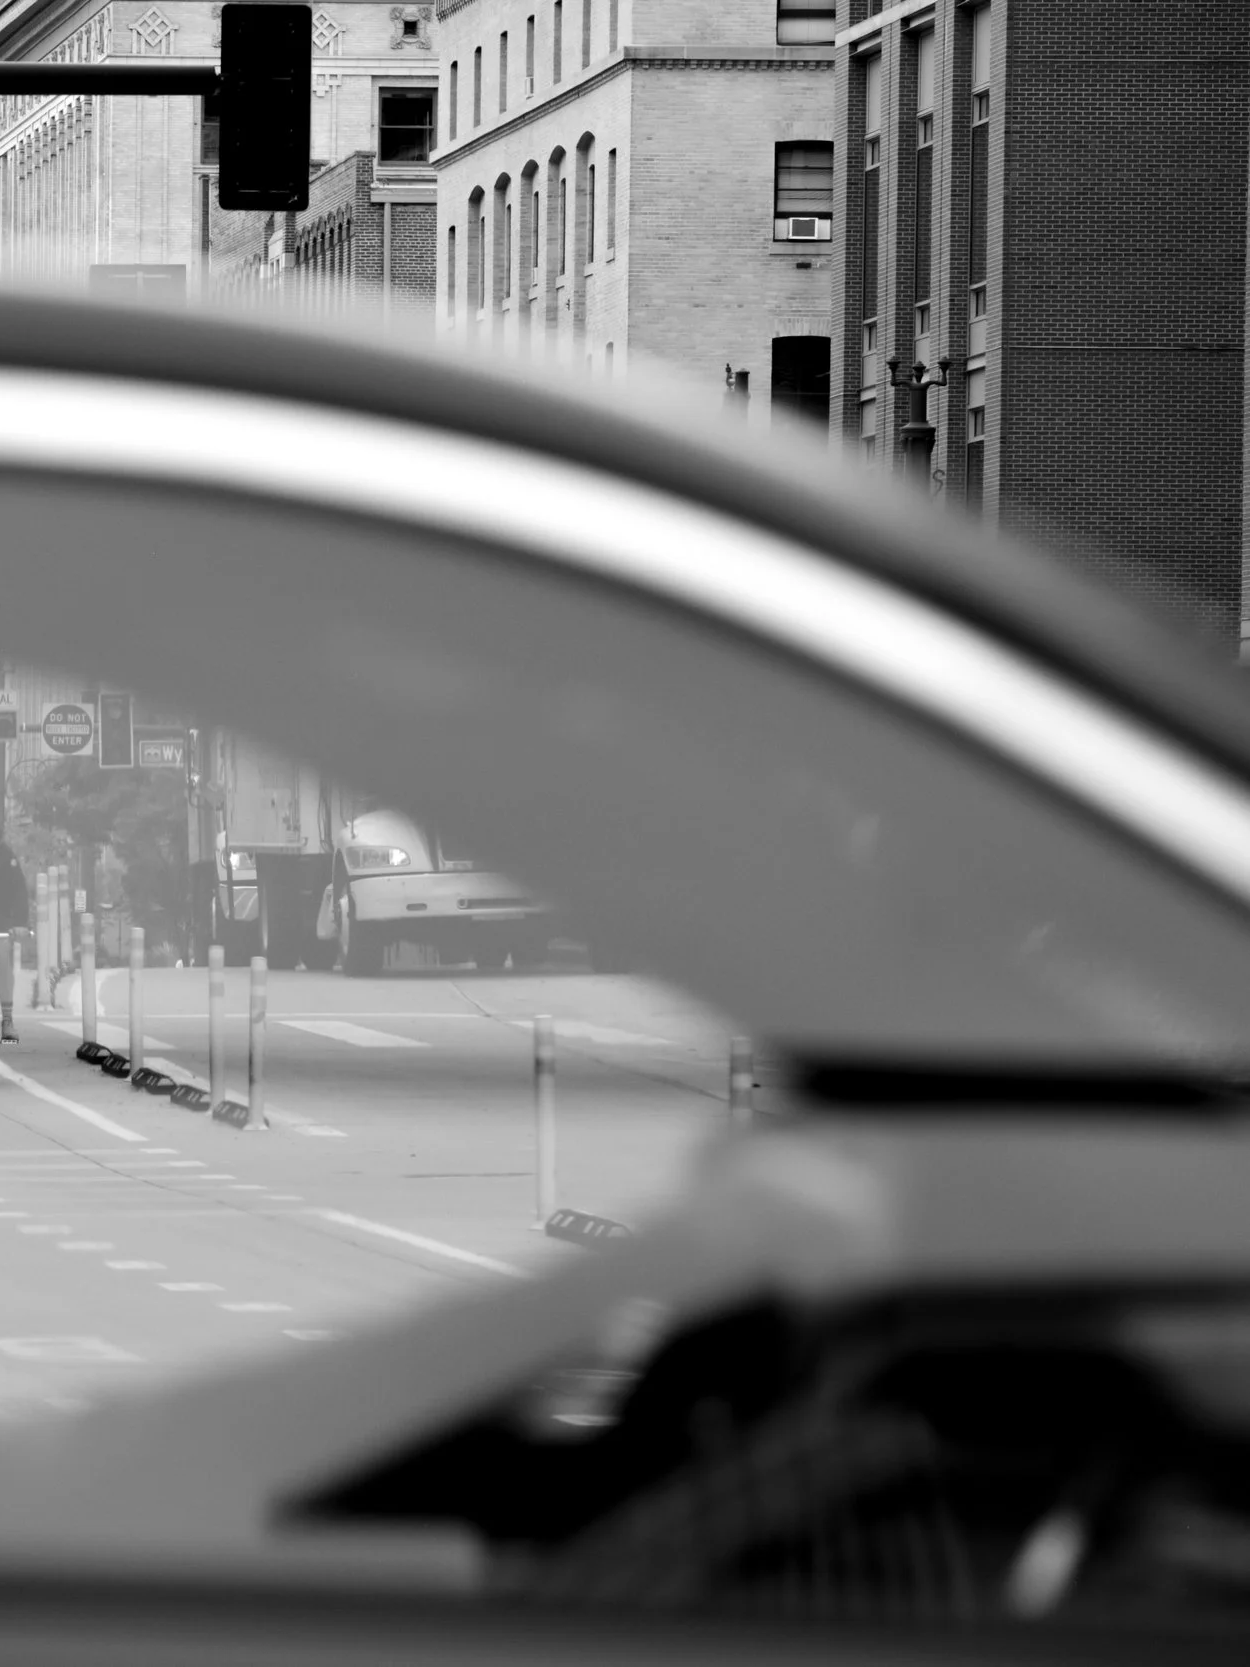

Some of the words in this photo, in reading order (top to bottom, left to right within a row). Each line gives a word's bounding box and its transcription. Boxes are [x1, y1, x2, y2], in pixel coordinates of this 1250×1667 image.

[50, 712, 63, 722] DO
[67, 712, 87, 723] NOT
[52, 735, 82, 746] ENTER
